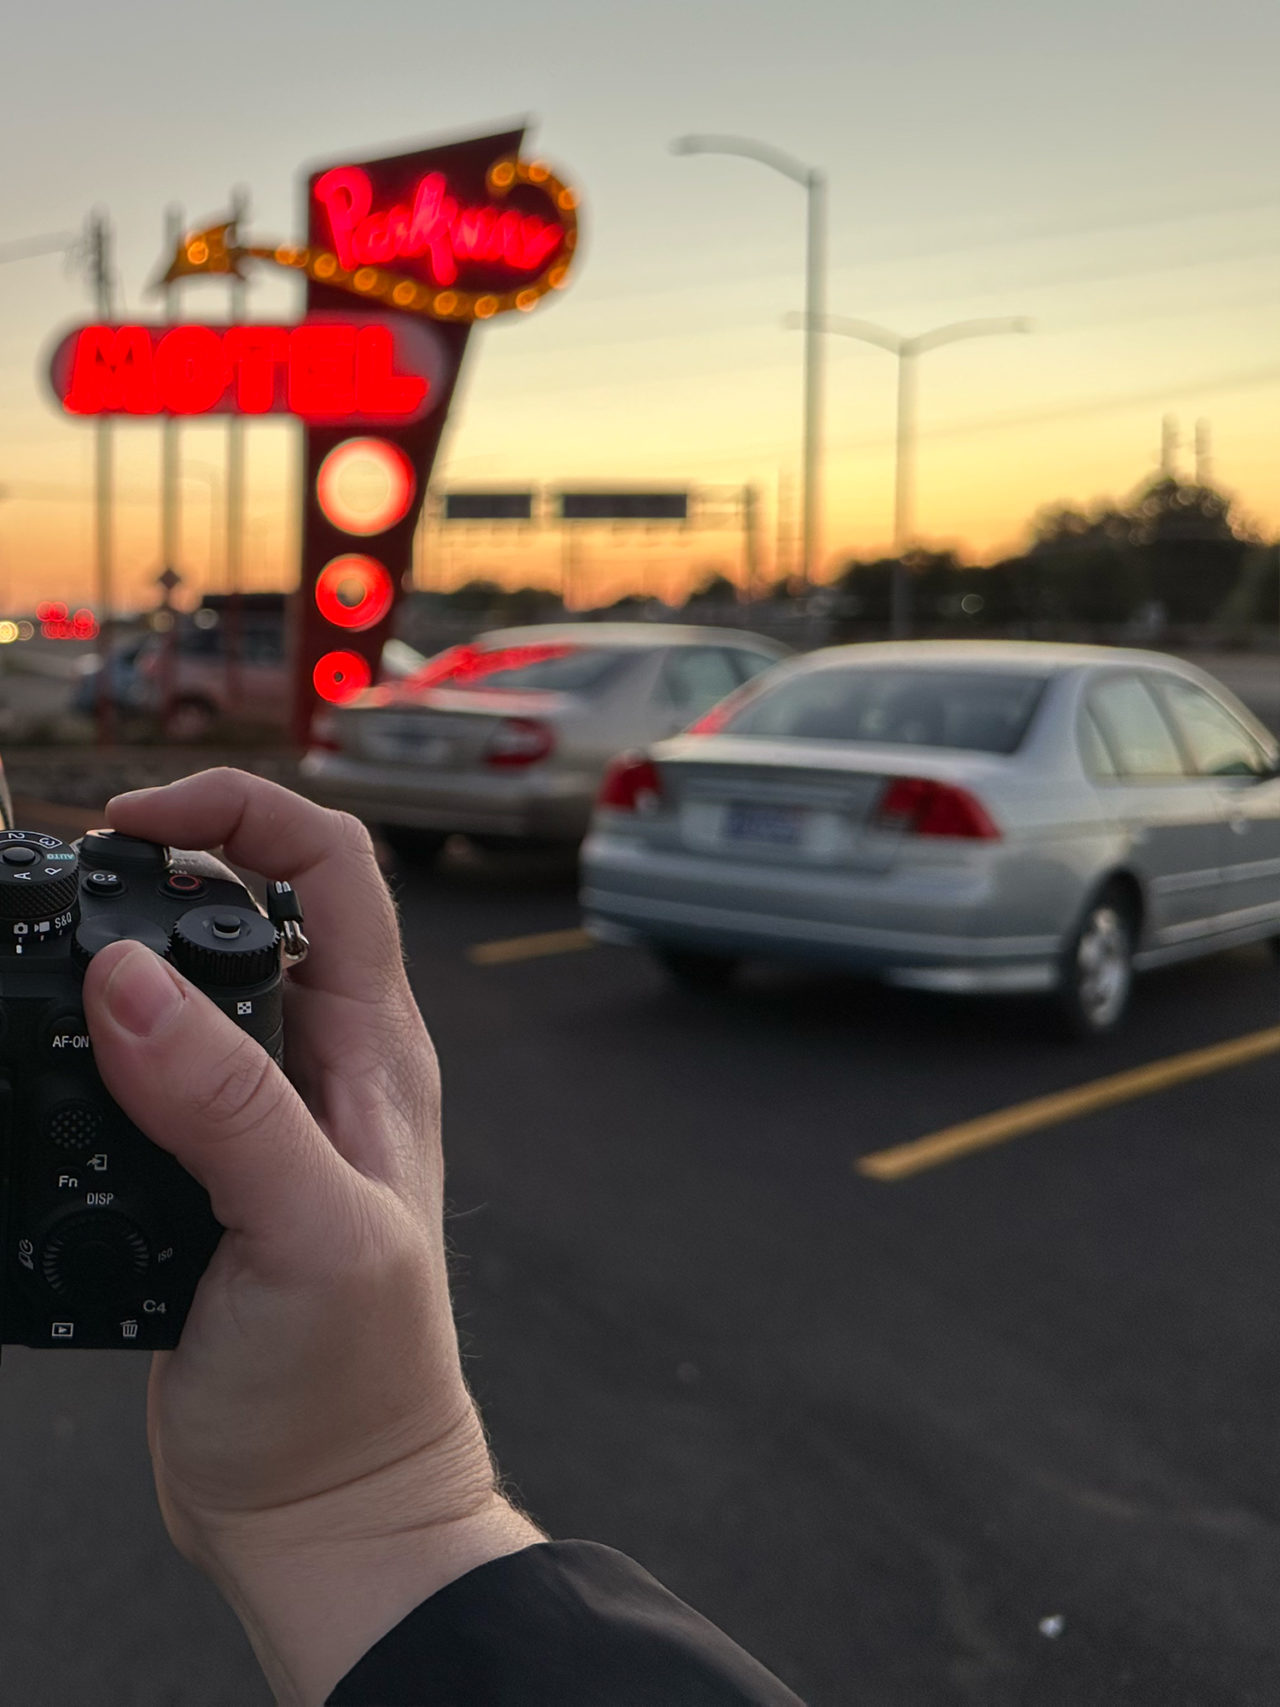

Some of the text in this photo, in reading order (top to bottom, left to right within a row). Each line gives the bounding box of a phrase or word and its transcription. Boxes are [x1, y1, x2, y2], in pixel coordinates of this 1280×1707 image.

[63, 325, 429, 414] MOTEL
[39, 837, 55, 846] 3
[13, 871, 31, 880] A
[44, 866, 62, 875] P
[92, 872, 117, 882] C2
[54, 911, 72, 929] S&Q
[52, 1035, 89, 1049] AF-ON
[58, 1175, 78, 1187] Fn
[86, 1192, 114, 1205] DISP
[143, 1299, 167, 1314] C4
